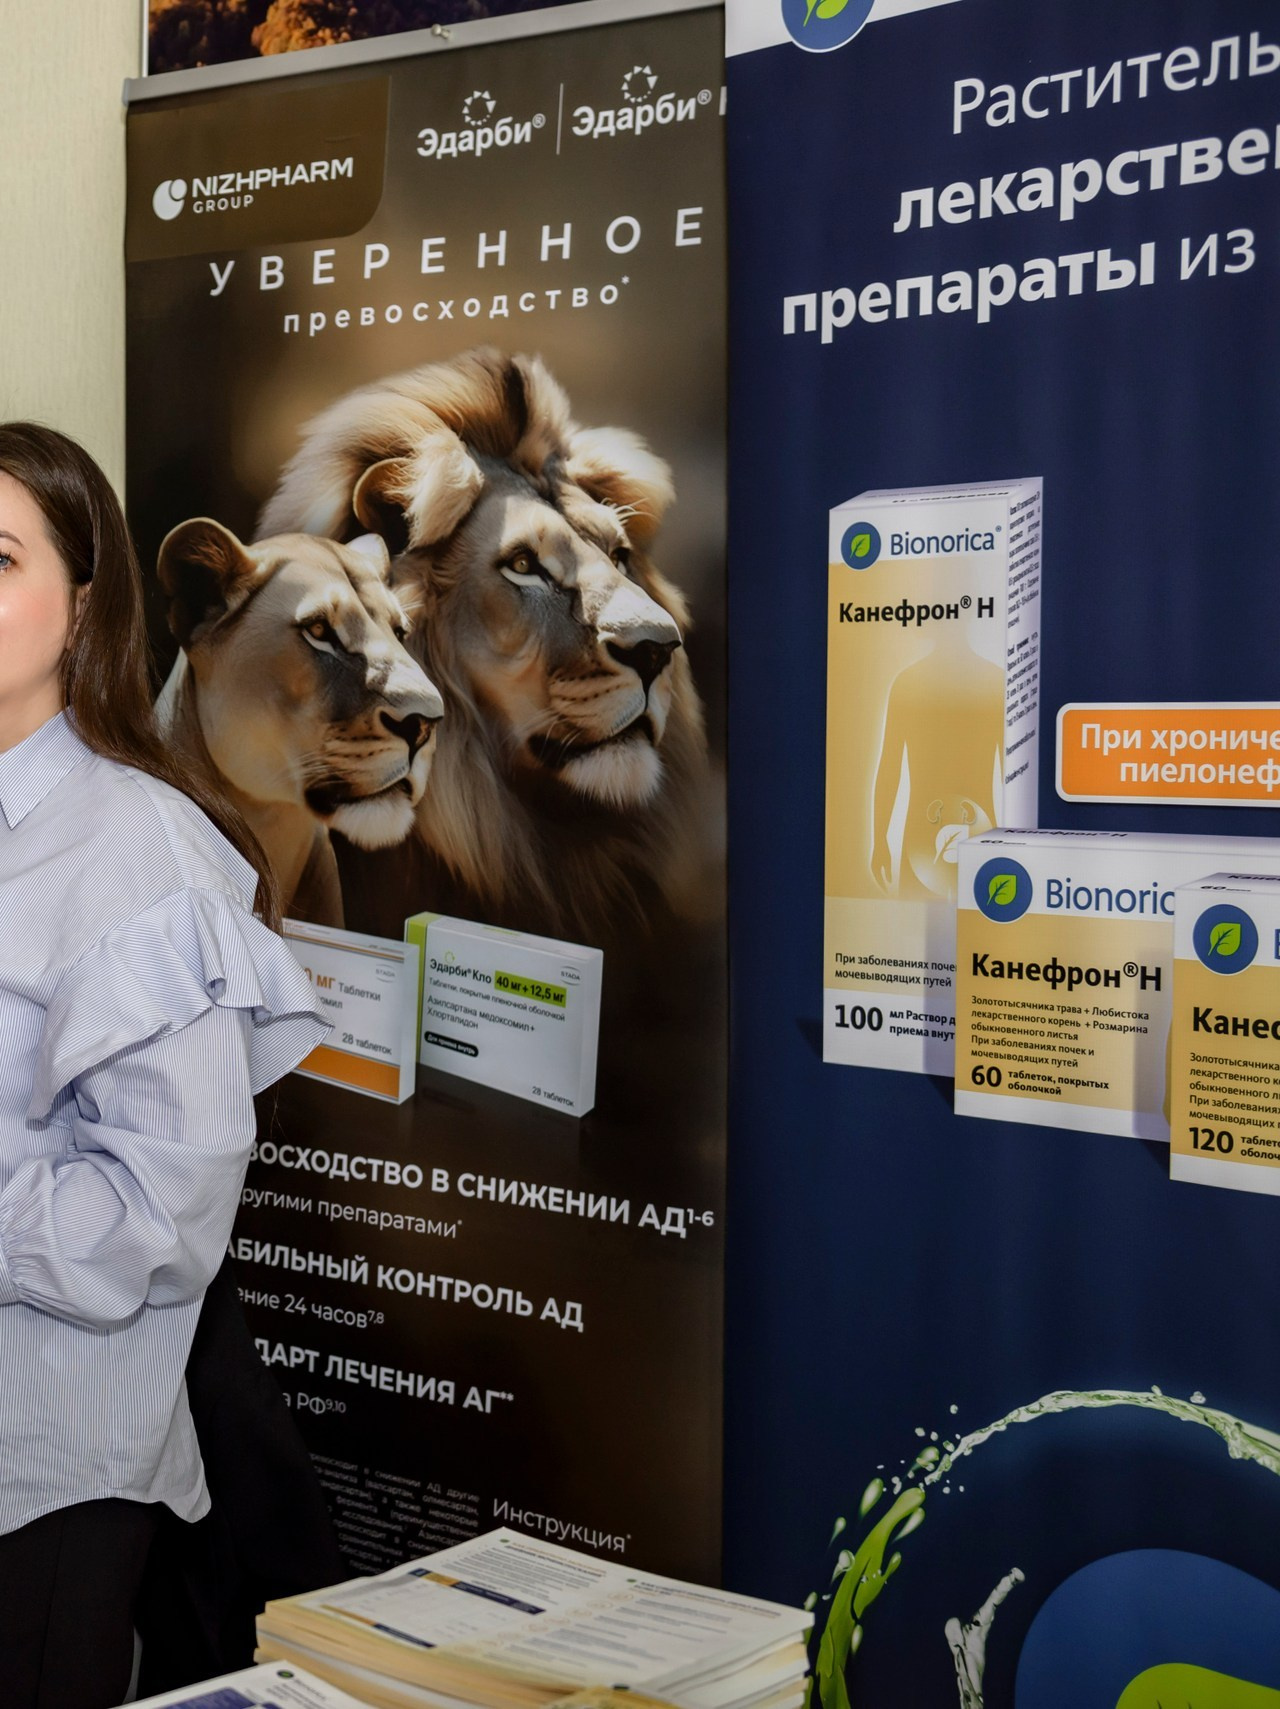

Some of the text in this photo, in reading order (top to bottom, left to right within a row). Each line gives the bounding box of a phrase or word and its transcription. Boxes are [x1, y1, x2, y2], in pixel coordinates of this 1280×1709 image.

[952, 31, 1280, 135] Раститель
[192, 157, 353, 197] NIZHPHARM
[893, 124, 1280, 233] лекарстве
[192, 194, 254, 214] GROUP
[209, 207, 703, 295] УВЕРЕННОЕ
[783, 228, 1256, 344] препараты из
[1081, 723, 1280, 756] При хрониче
[1120, 760, 1280, 793] пиелонеф
[835, 953, 957, 973] При заболеваниях поче
[472, 969, 492, 984] Кло
[496, 975, 509, 989] 40
[510, 981, 522, 993] мг
[530, 984, 551, 1001] 12,5
[553, 992, 565, 1004] мг
[560, 969, 581, 981] STADA
[835, 969, 952, 989] мочевыводящих путей
[339, 982, 381, 1001] Таблетки
[427, 994, 478, 1017] Азилсартана
[459, 986, 491, 1002] покрытые
[492, 993, 528, 1011] пленочной
[528, 1003, 566, 1022] оболочкой
[971, 996, 1055, 1012] Золототысячника
[1056, 1004, 1082, 1015] трава
[1092, 1006, 1150, 1021] Любистока
[427, 1006, 479, 1030] Хлорталидон
[835, 1004, 883, 1032] 100
[889, 1010, 904, 1019] мл
[906, 1010, 947, 1025] Раствор
[971, 1009, 1046, 1025] лекарственного
[1048, 1017, 1081, 1029] корень
[1093, 1020, 1148, 1035] Розмарина
[889, 1025, 929, 1037] приема
[971, 1022, 1079, 1042] обыкновенного листья
[342, 1032, 393, 1055] 28 таблеток
[972, 1035, 1095, 1057] При заболеваниях почек и
[971, 1050, 1078, 1069] мочевыводящих путей
[1190, 1052, 1280, 1071] Золототысячника
[972, 1064, 1109, 1090] 60 таблеток, покрытых
[1190, 1067, 1270, 1086] лекарственного
[532, 1085, 575, 1107] 28 таблеток
[1008, 1082, 1062, 1096] оболочкой
[1190, 1081, 1270, 1099] обыкновенного
[1189, 1095, 1209, 1109] При
[1189, 1110, 1275, 1129] мочевыводящих
[1189, 1127, 1234, 1154] 120
[241, 1185, 313, 1215] ругими
[431, 1168, 449, 1194] В
[456, 1173, 630, 1225] СНИЖЕНИИ
[284, 1293, 308, 1316] 24
[376, 1264, 534, 1316] КОНТРОЛЬ
[540, 1298, 584, 1333] АД
[324, 1355, 455, 1405] ЛЕЧЕНИЯ
